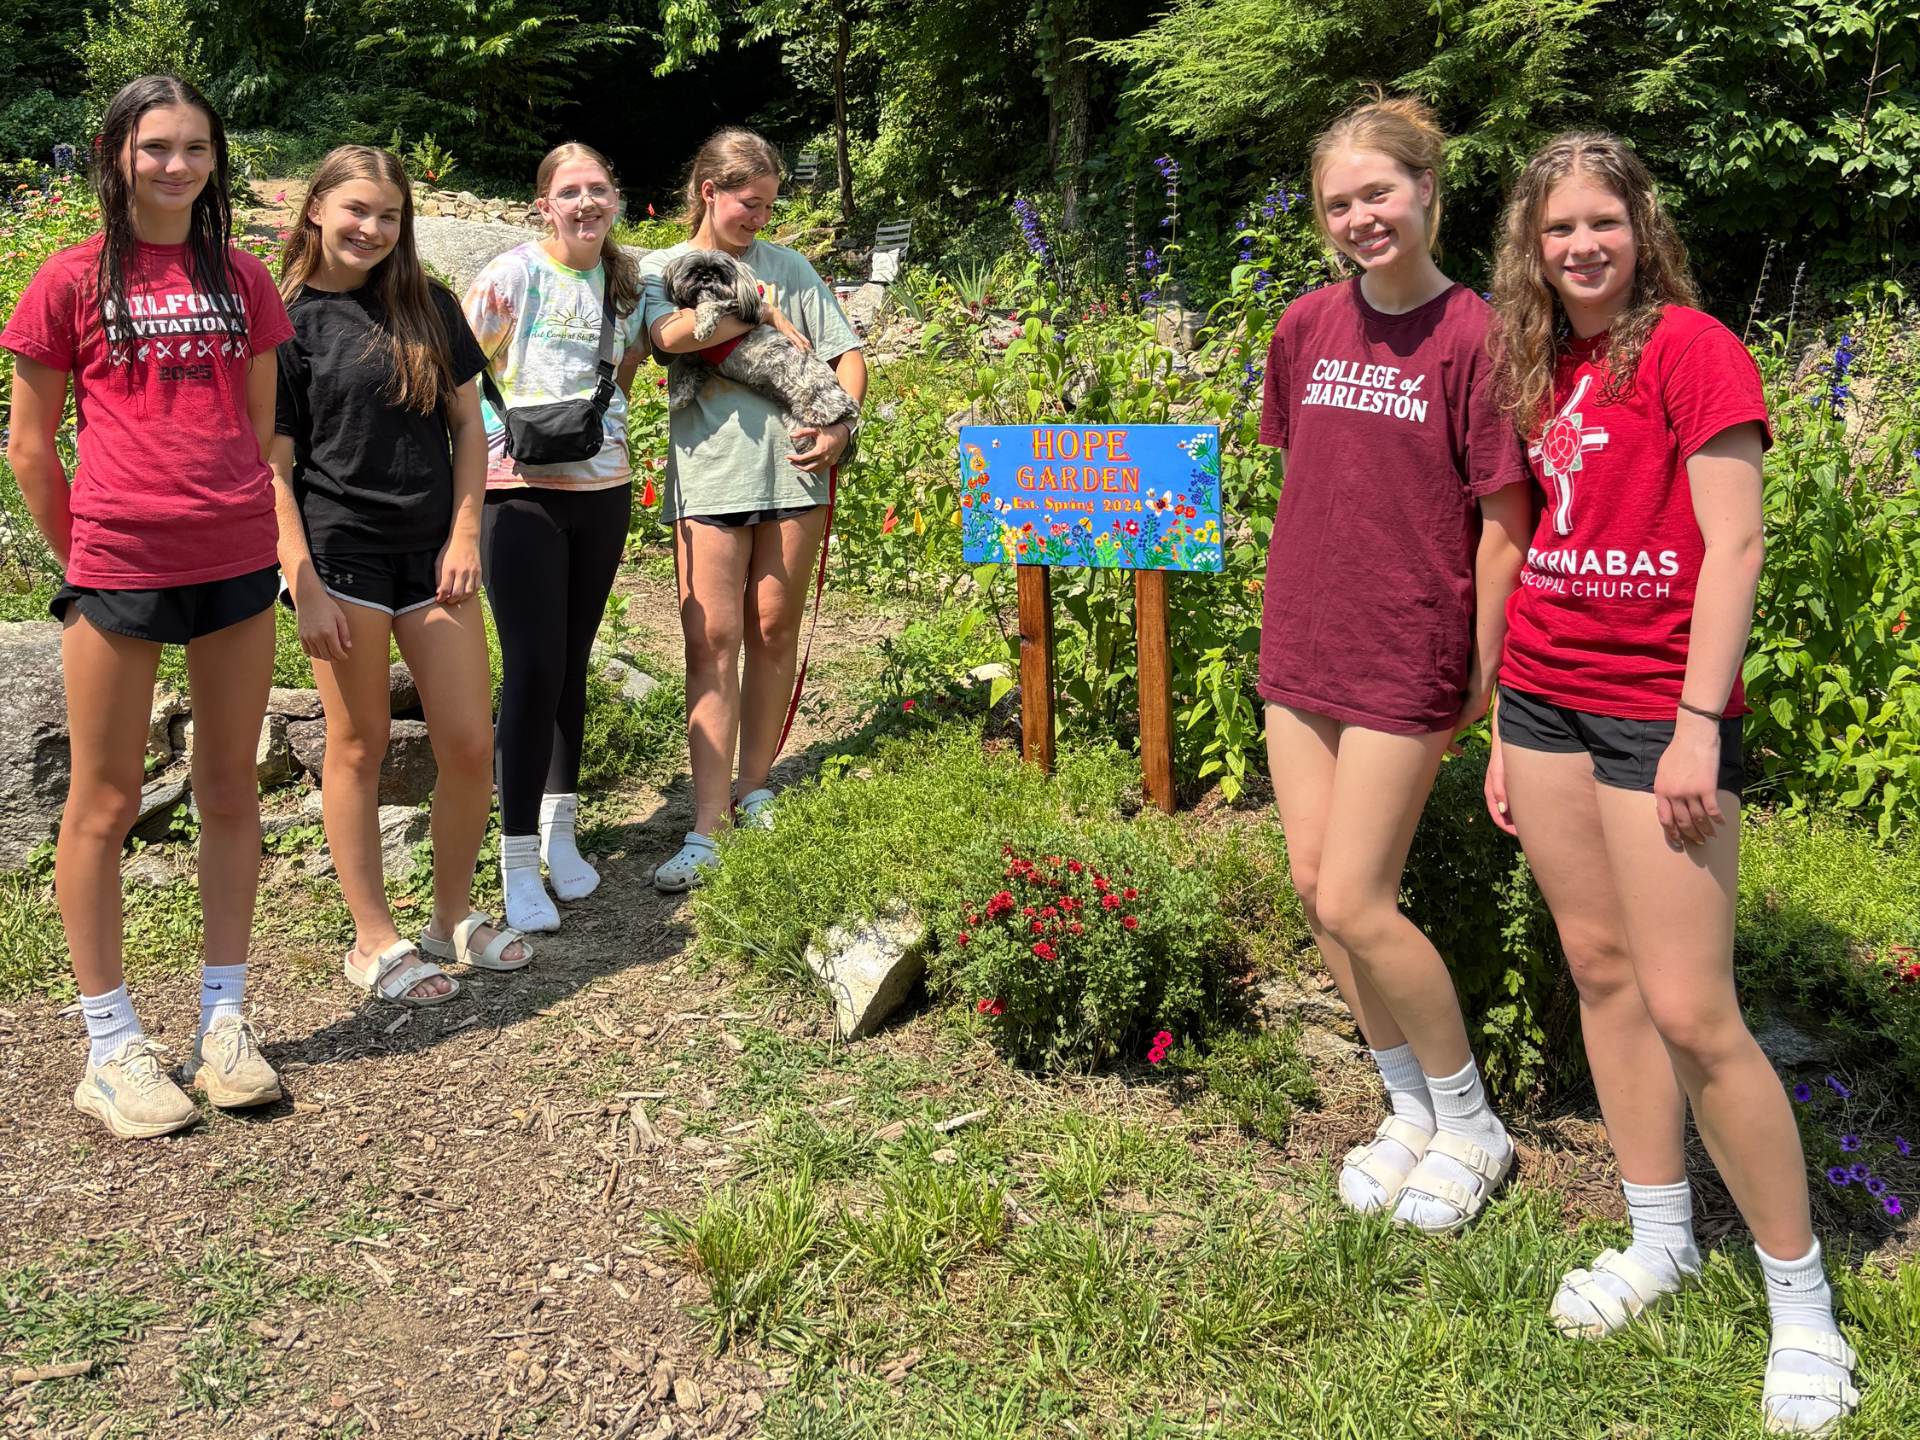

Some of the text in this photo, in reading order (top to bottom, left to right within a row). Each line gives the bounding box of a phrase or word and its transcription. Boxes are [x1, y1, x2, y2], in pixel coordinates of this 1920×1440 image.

[107, 316, 248, 341] IVITATIONA
[159, 364, 213, 382] 2025
[1312, 358, 1425, 397] COLLEGE of
[1032, 429, 1130, 461] HOPE
[1016, 466, 1140, 493] GARDEN
[1012, 497, 1142, 514] Est. Spring 2024
[1527, 547, 1680, 576] BARNABAS
[1571, 581, 1670, 599] CHURCH
